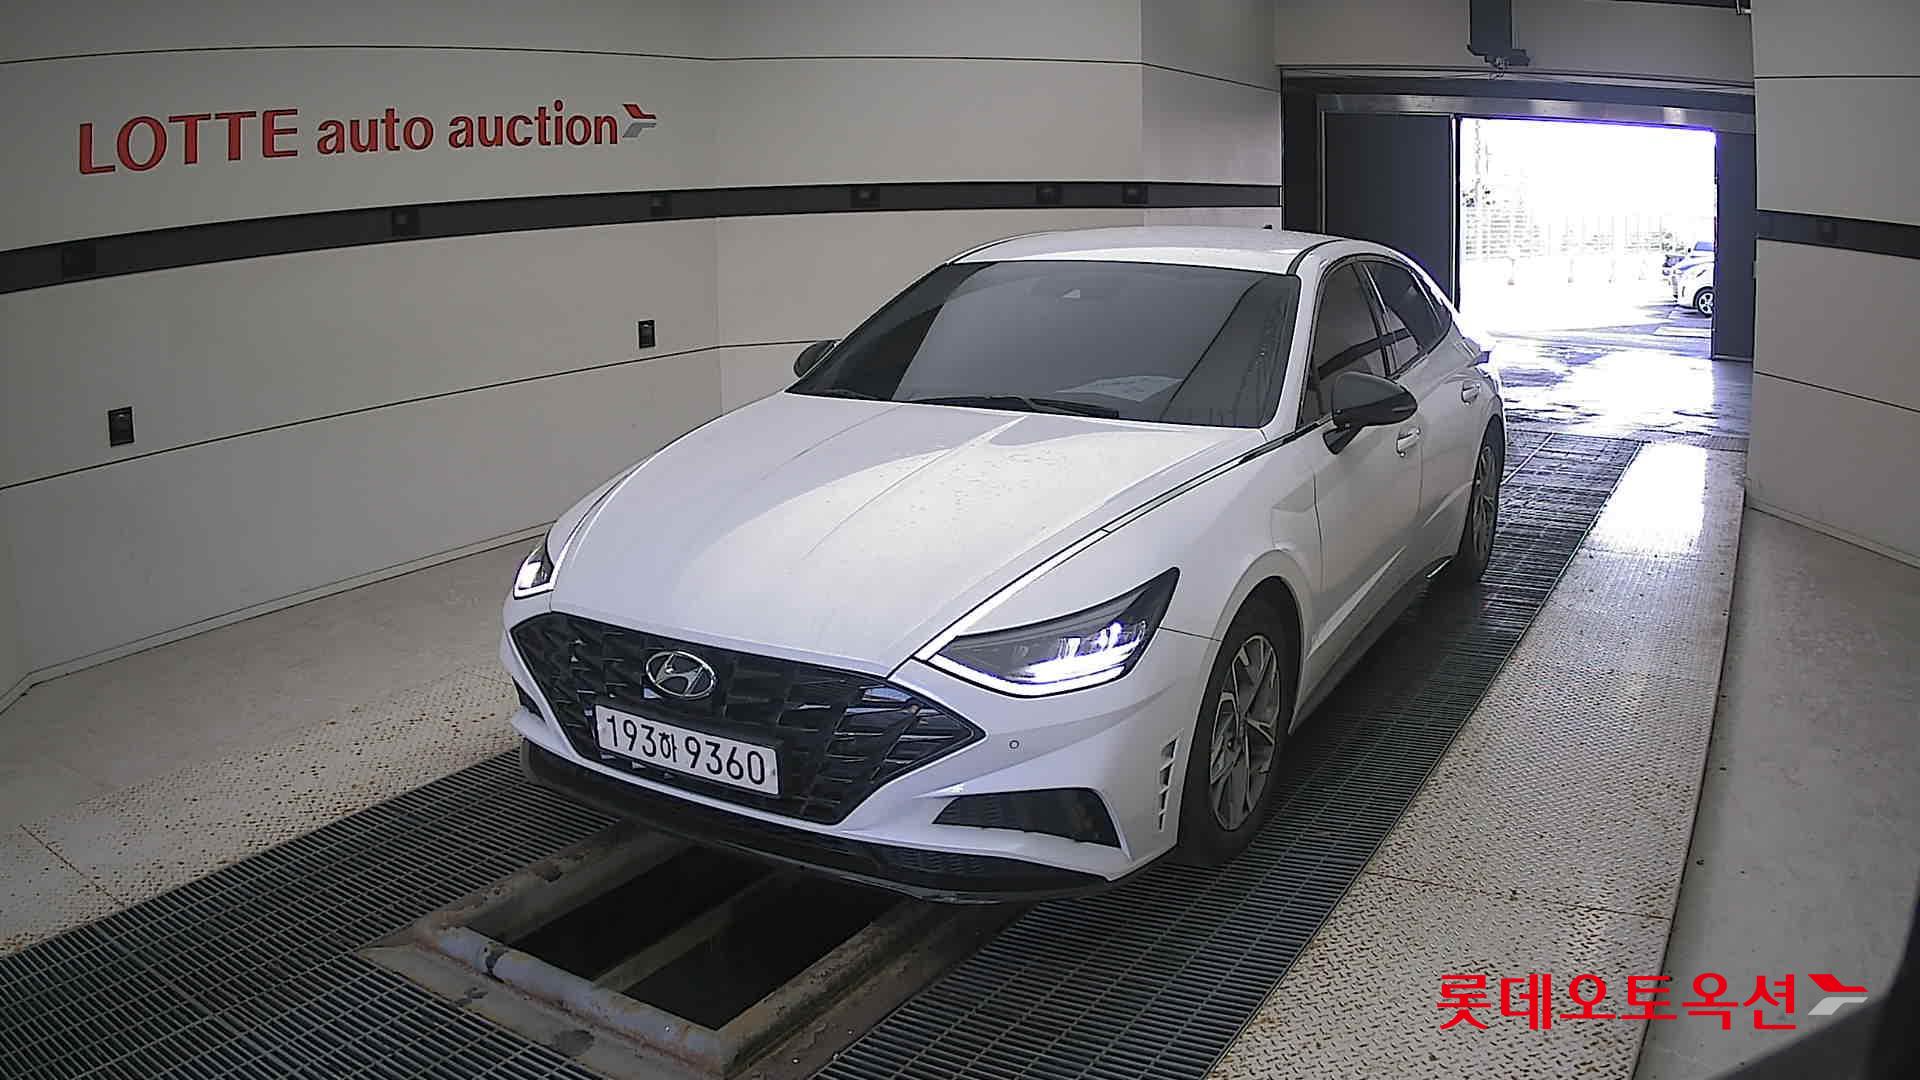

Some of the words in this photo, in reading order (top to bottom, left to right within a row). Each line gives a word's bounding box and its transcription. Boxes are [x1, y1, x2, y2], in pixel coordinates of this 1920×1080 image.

[79, 108, 298, 175] LOTTE
[316, 107, 434, 156] auto
[447, 100, 619, 149] auction
